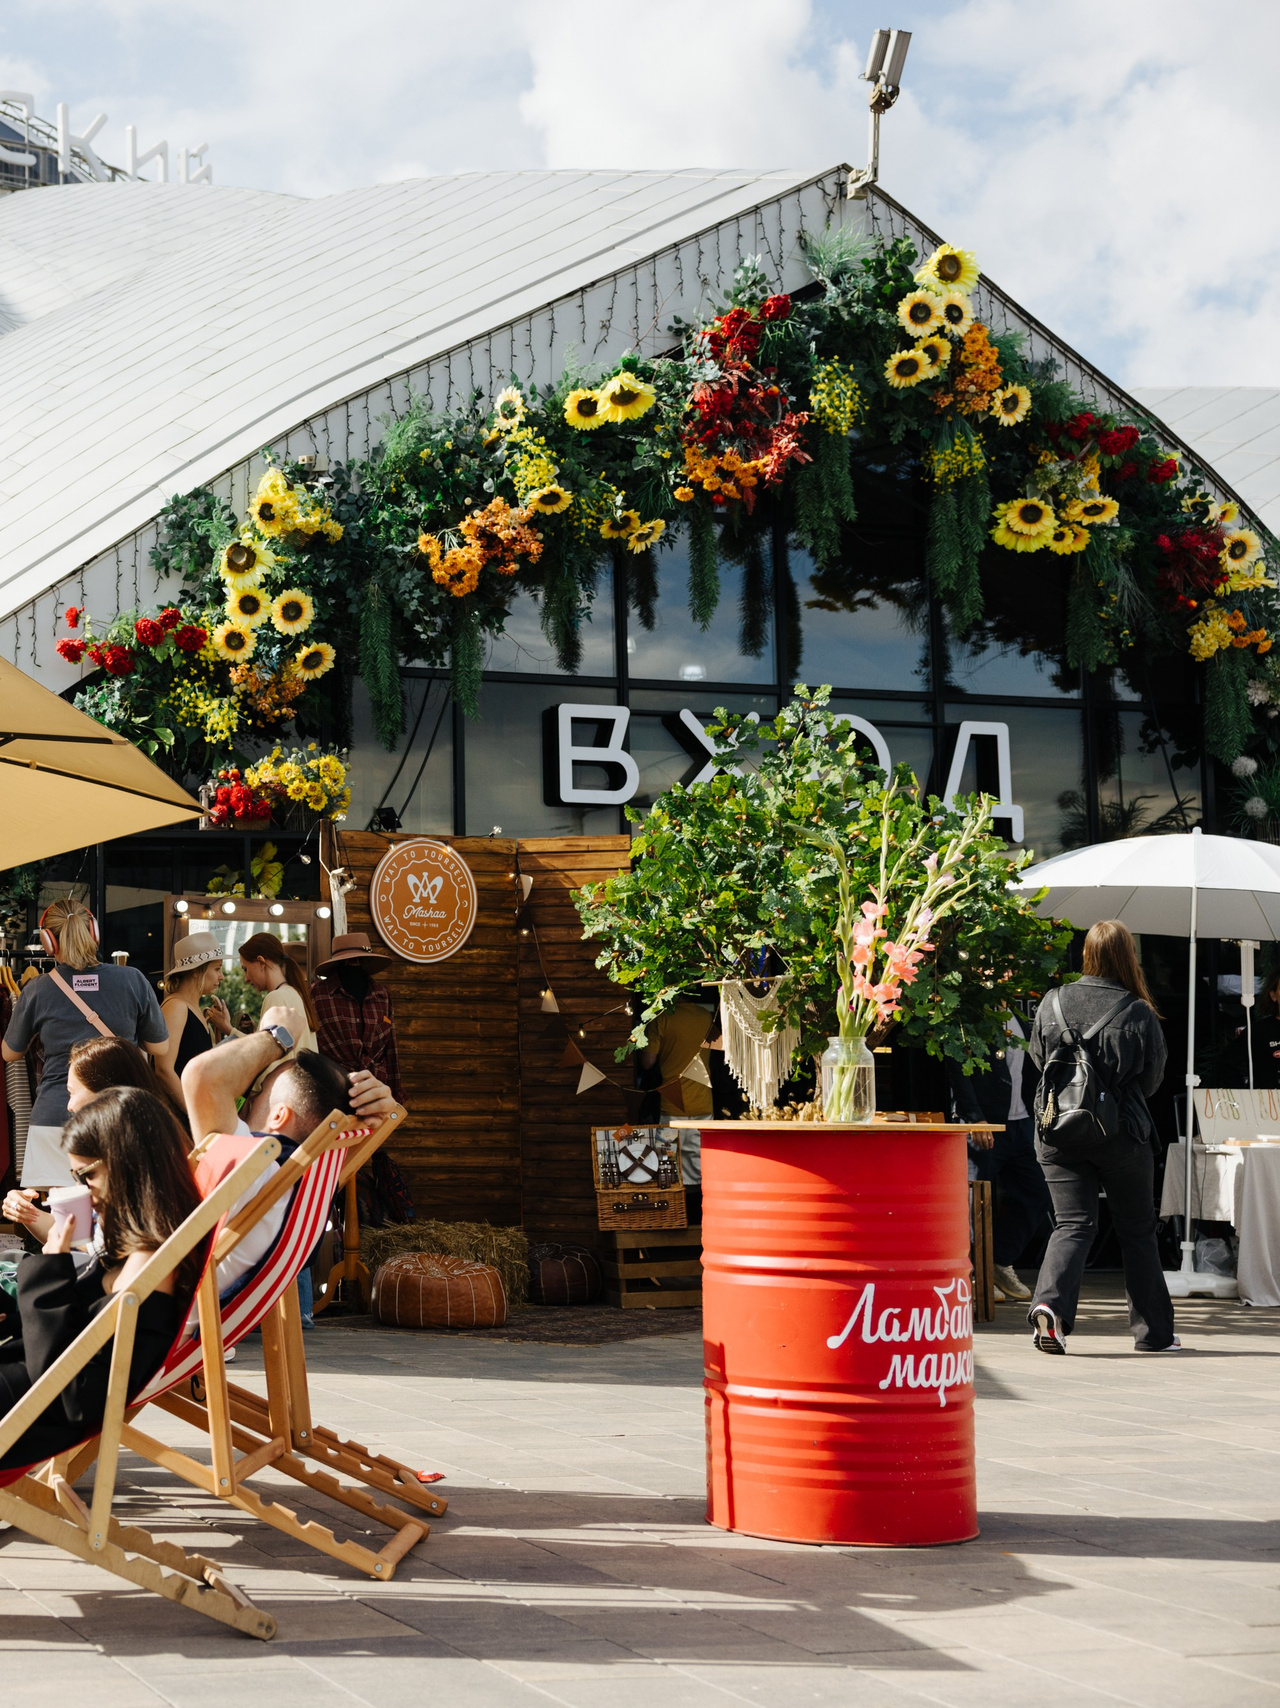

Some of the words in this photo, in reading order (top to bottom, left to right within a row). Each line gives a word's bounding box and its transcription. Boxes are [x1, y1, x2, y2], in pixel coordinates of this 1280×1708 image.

[384, 862, 399, 883] WAY
[403, 850, 416, 861] TO
[423, 849, 467, 889] YOURSELF
[403, 904, 447, 919] Mashaa
[384, 915, 399, 936] WAY
[402, 938, 415, 950] TO
[422, 919, 465, 952] YOURSELF
[826, 1277, 972, 1349] Ламбад
